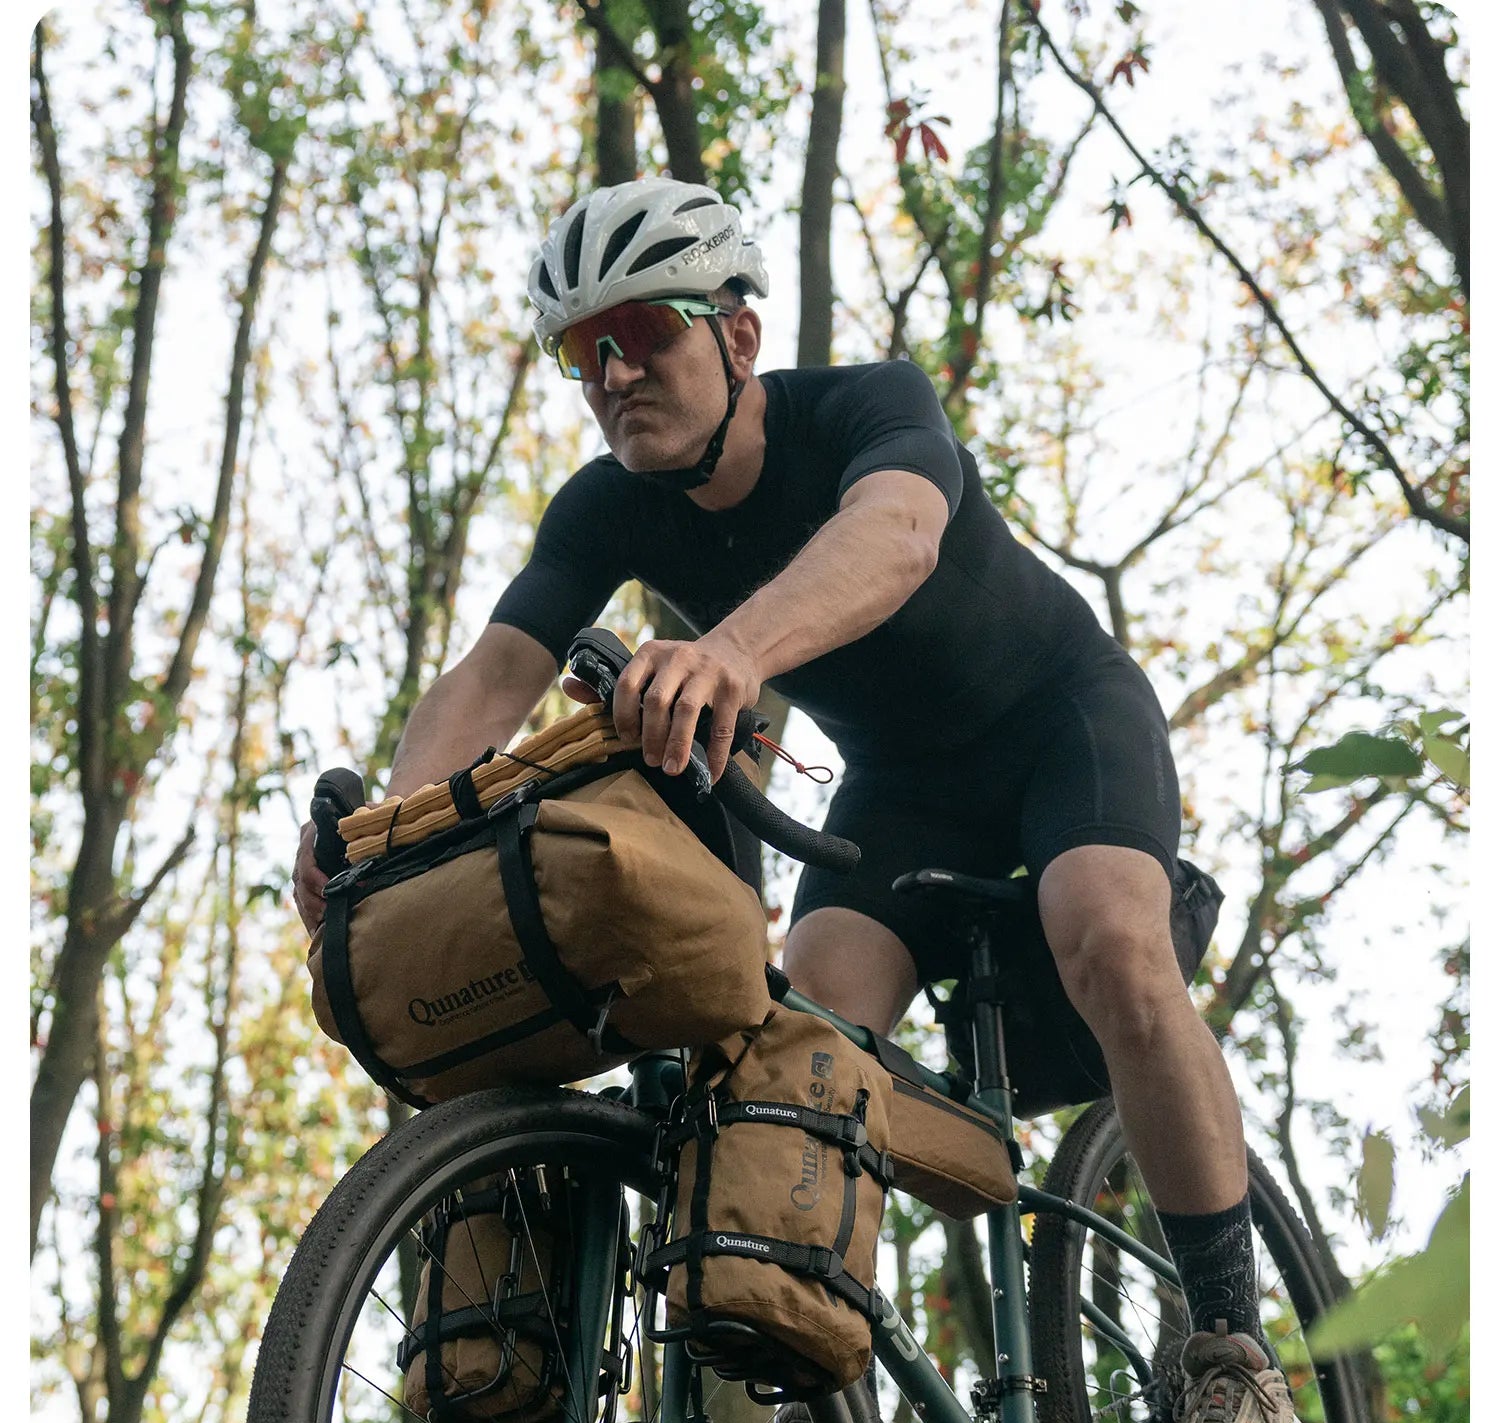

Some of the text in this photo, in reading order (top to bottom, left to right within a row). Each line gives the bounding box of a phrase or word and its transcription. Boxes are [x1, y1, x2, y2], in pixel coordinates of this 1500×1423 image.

[681, 224, 735, 265] ROCKBROS
[408, 967, 519, 1026] Qunature
[745, 1104, 798, 1119] Qunature
[716, 1235, 770, 1252] Qunature
